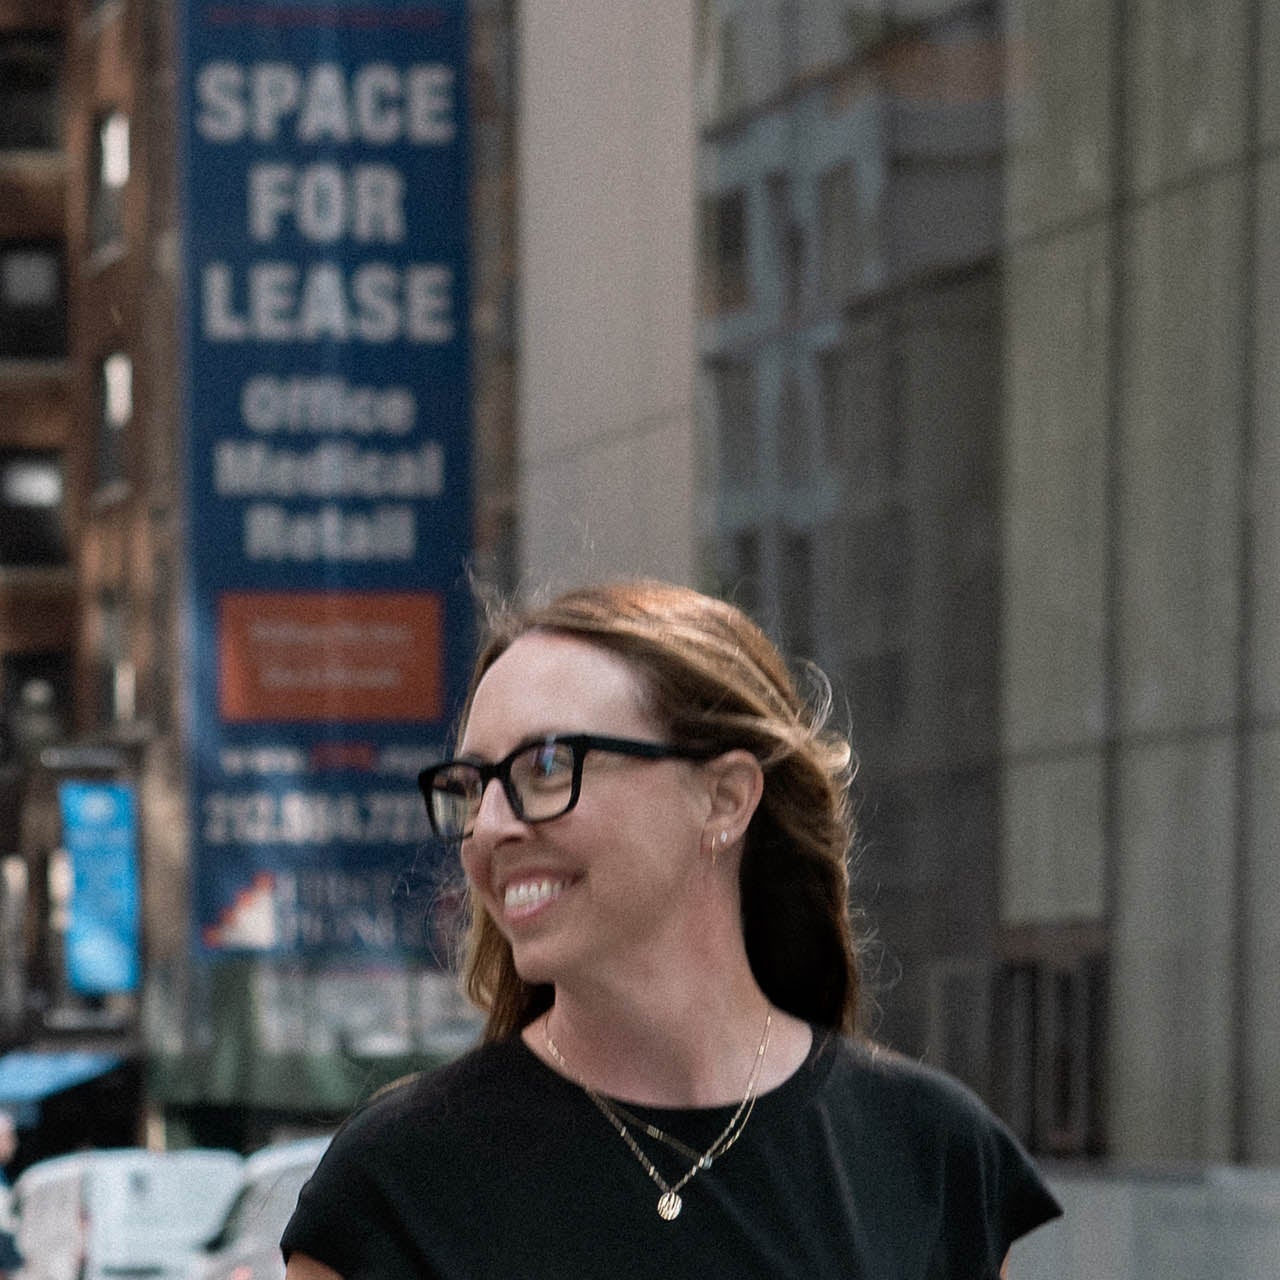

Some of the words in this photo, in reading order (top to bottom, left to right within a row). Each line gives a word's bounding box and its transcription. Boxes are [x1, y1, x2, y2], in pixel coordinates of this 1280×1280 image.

[198, 63, 454, 143] SPACE
[248, 165, 405, 243] FOR
[203, 264, 453, 341] LEASE
[243, 377, 416, 433] Office
[214, 440, 446, 497] Medical
[245, 505, 418, 560] Retail
